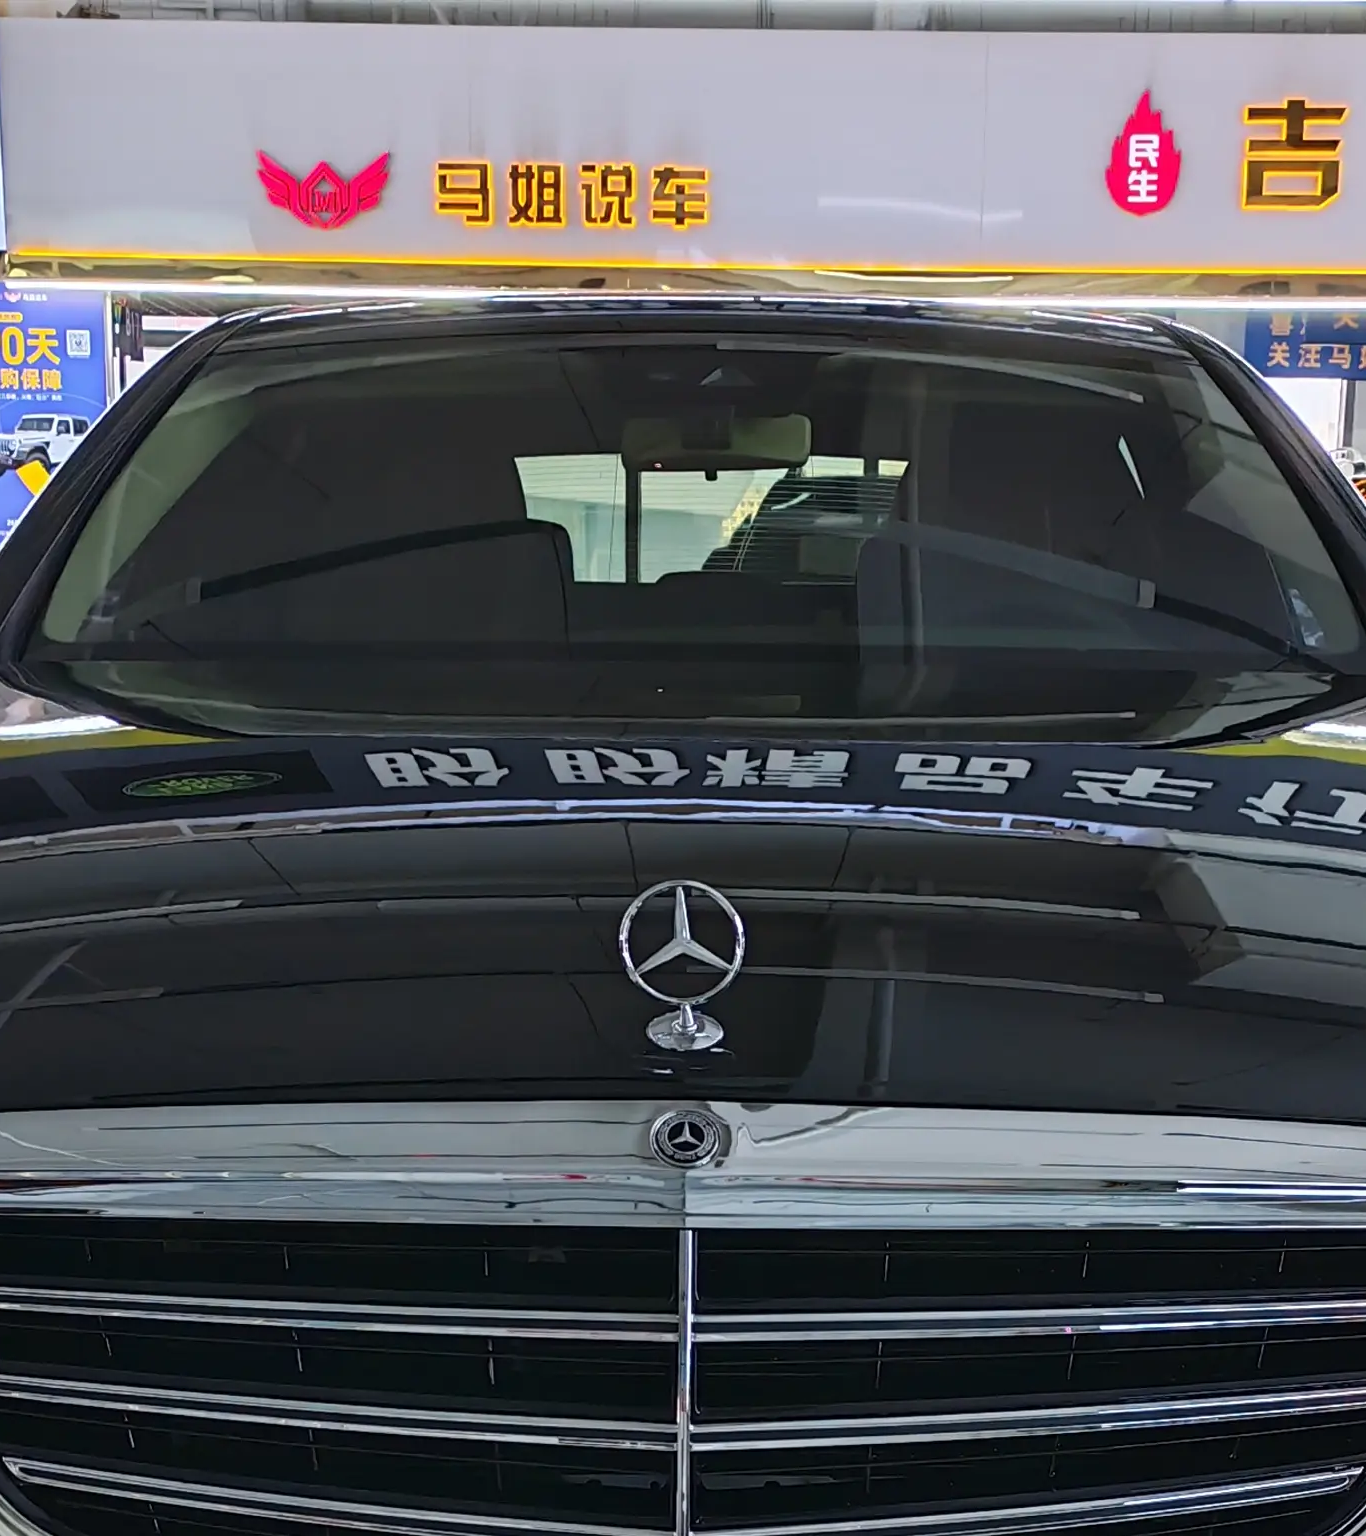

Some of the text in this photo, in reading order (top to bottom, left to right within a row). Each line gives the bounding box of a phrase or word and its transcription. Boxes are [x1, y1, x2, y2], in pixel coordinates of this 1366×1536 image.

[435, 161, 710, 230] 马姐说车
[1126, 132, 1160, 204] 民生
